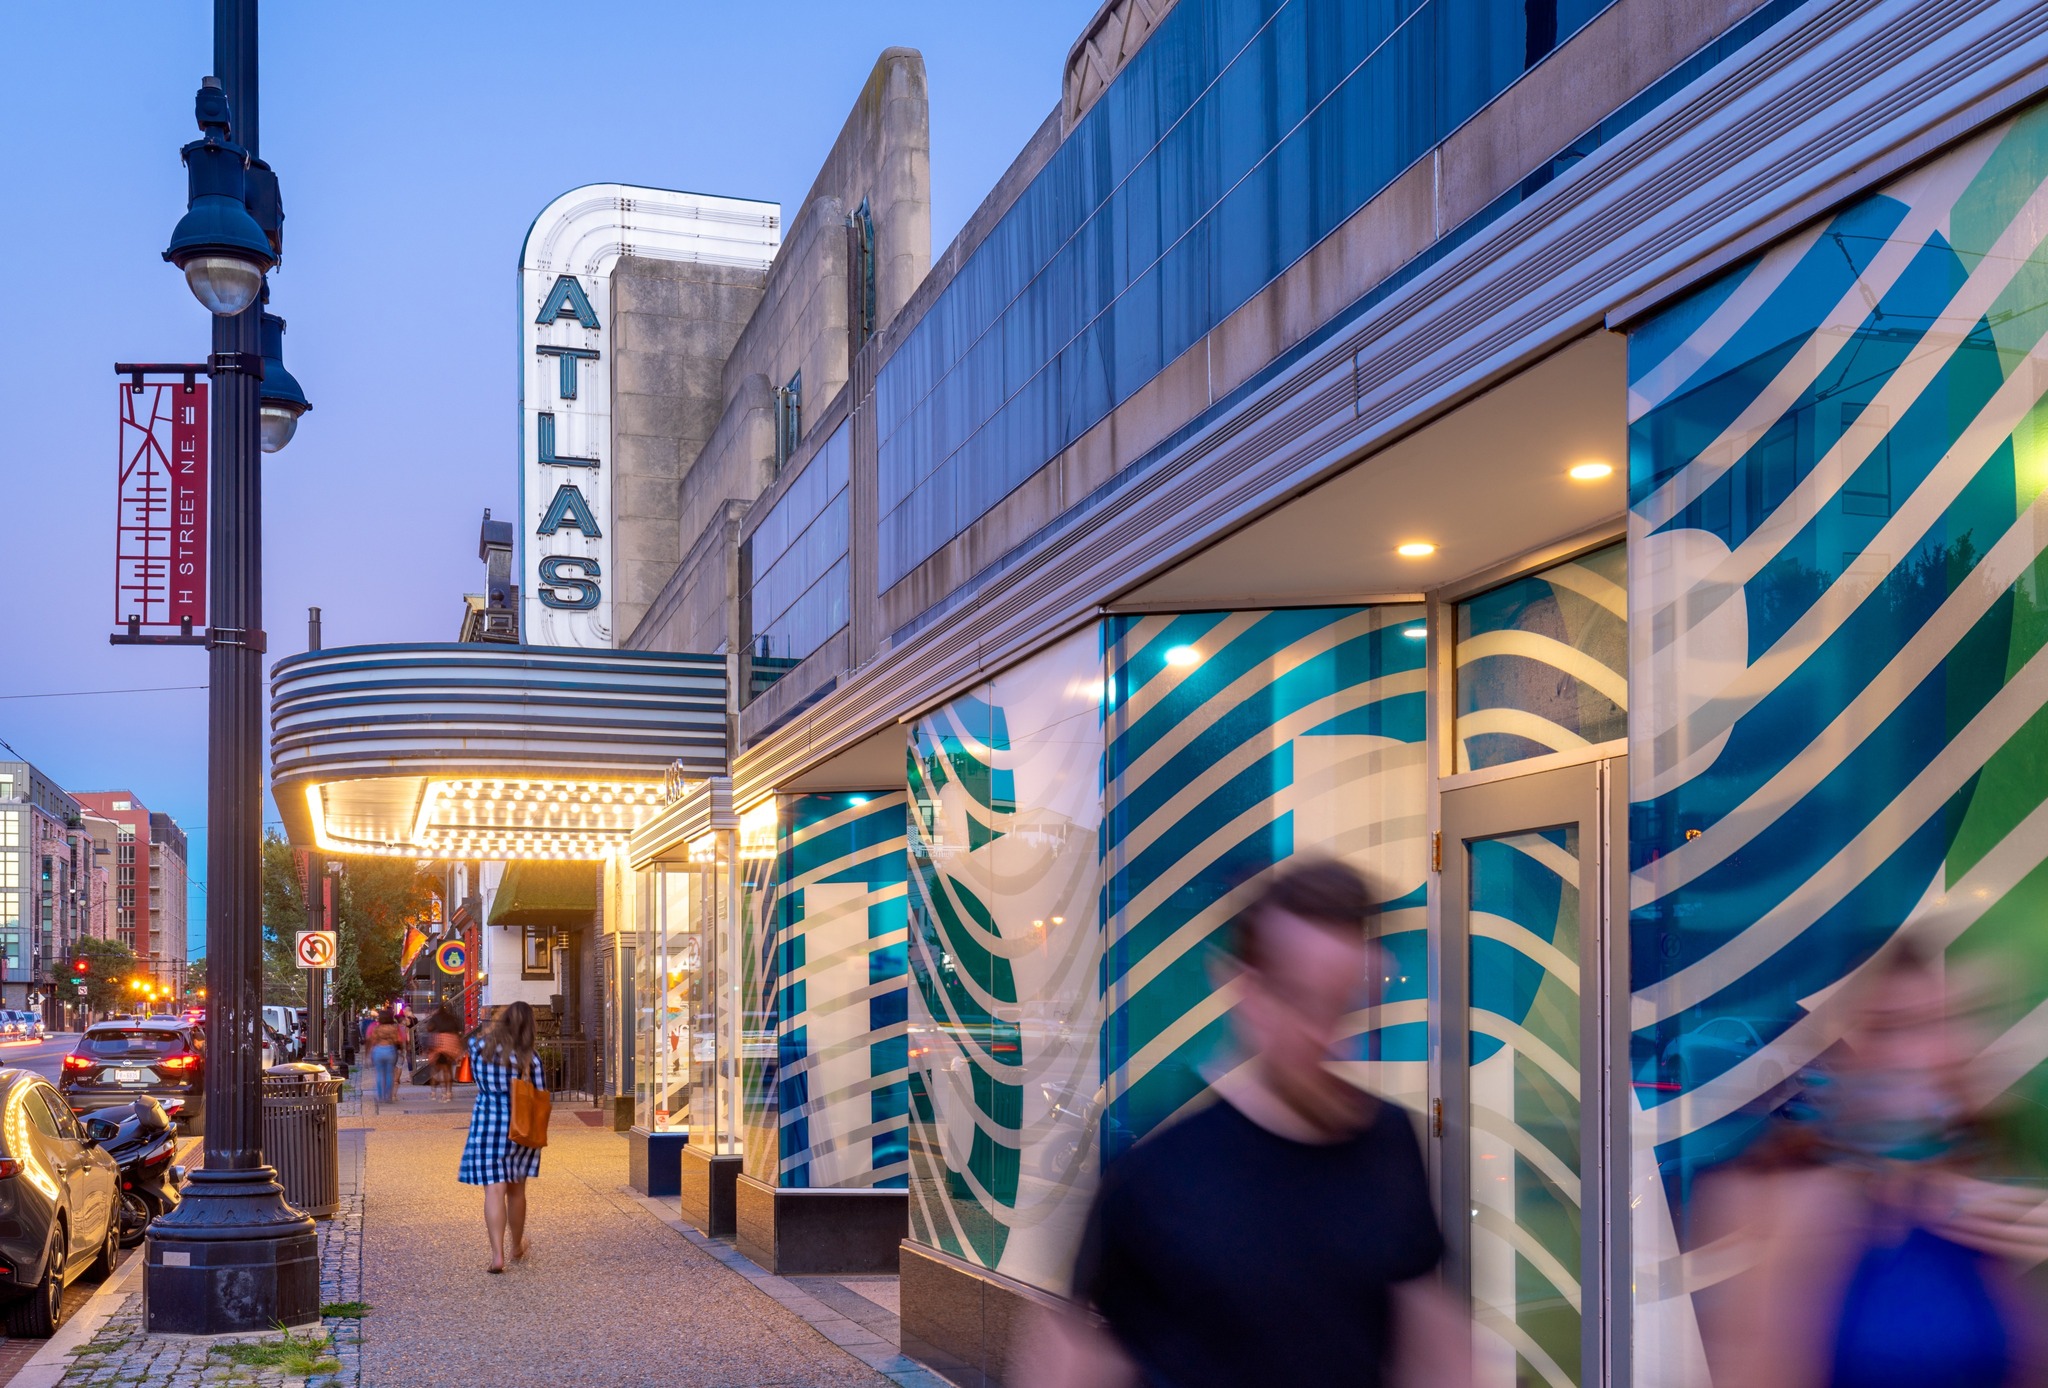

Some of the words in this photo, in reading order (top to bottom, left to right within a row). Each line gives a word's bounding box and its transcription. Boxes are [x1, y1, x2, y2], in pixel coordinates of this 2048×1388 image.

[180, 434, 195, 474] N.E.
[535, 274, 602, 610] ATLAS
[179, 485, 195, 575] STREET
[178, 590, 193, 603] H
